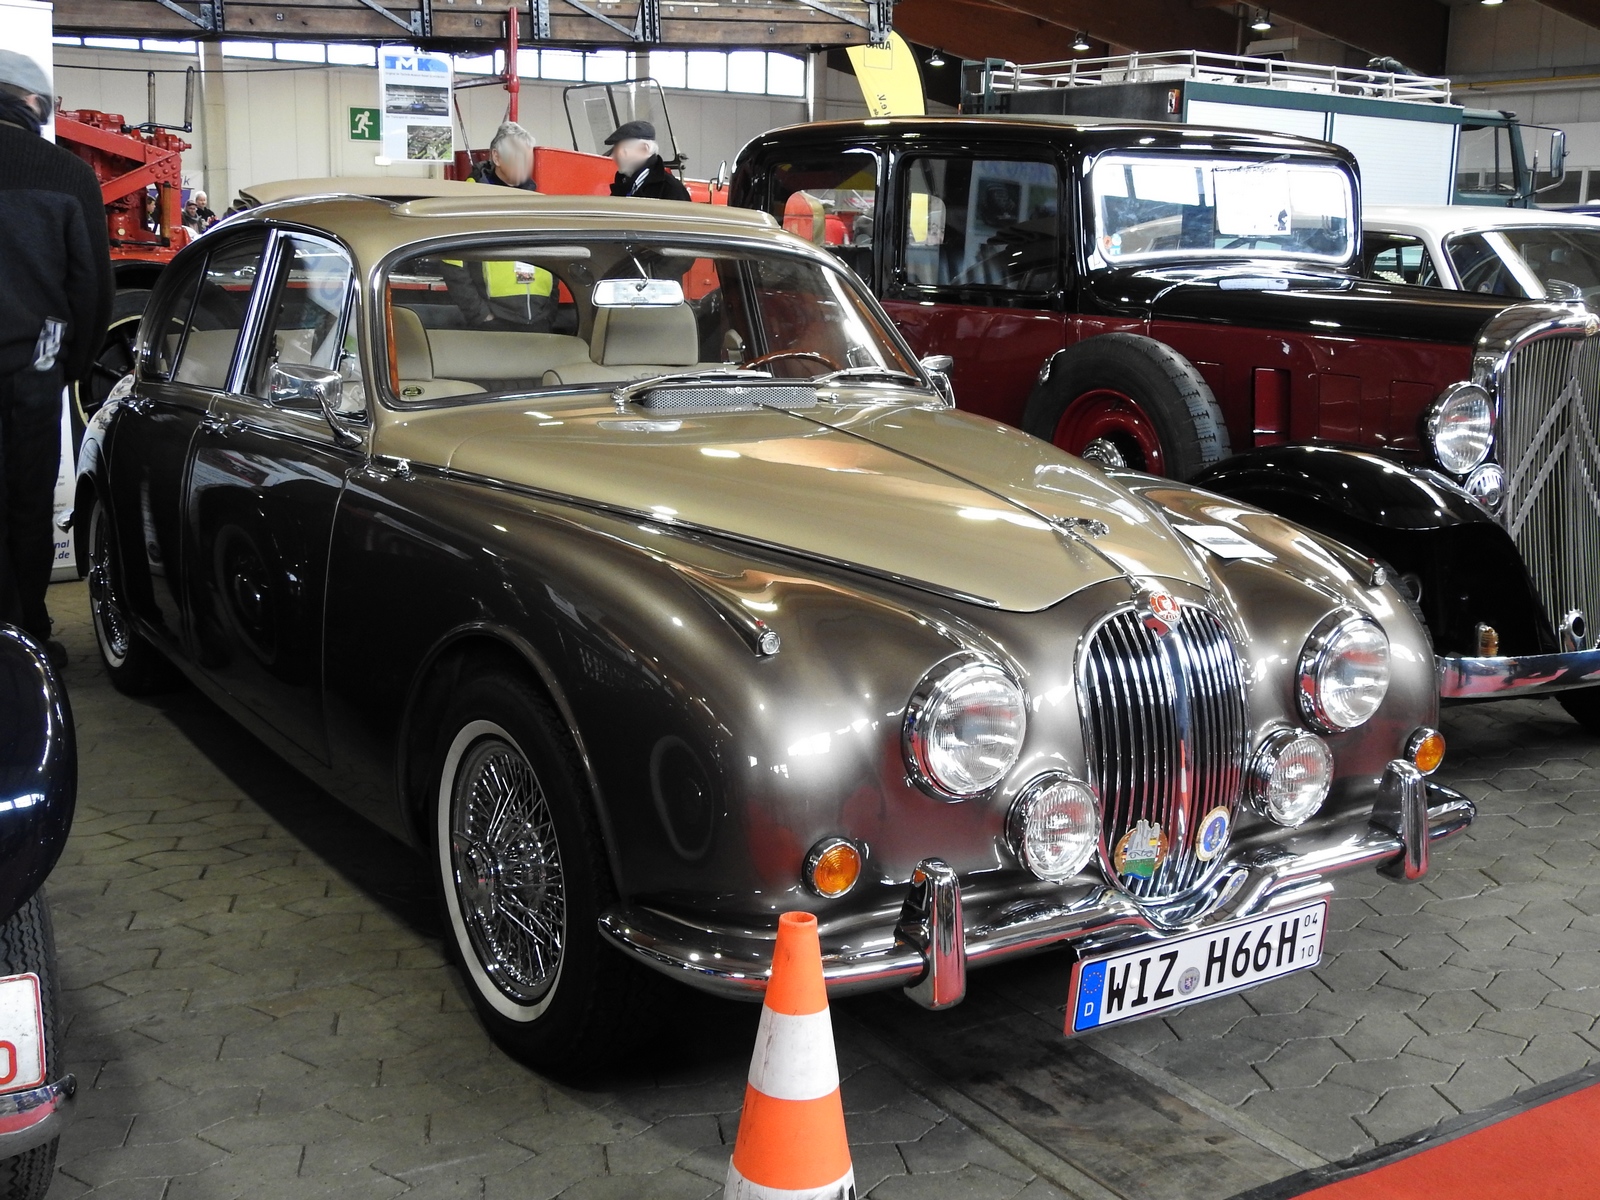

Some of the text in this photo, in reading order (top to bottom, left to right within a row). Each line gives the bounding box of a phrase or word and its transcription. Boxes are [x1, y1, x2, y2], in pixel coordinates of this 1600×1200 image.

[385, 55, 432, 71] TMK
[1304, 912, 1318, 927] 04
[1301, 944, 1315, 960] 10
[1106, 950, 1179, 1014] WIZ
[1204, 917, 1300, 988] H66H
[1084, 1002, 1094, 1017] D
